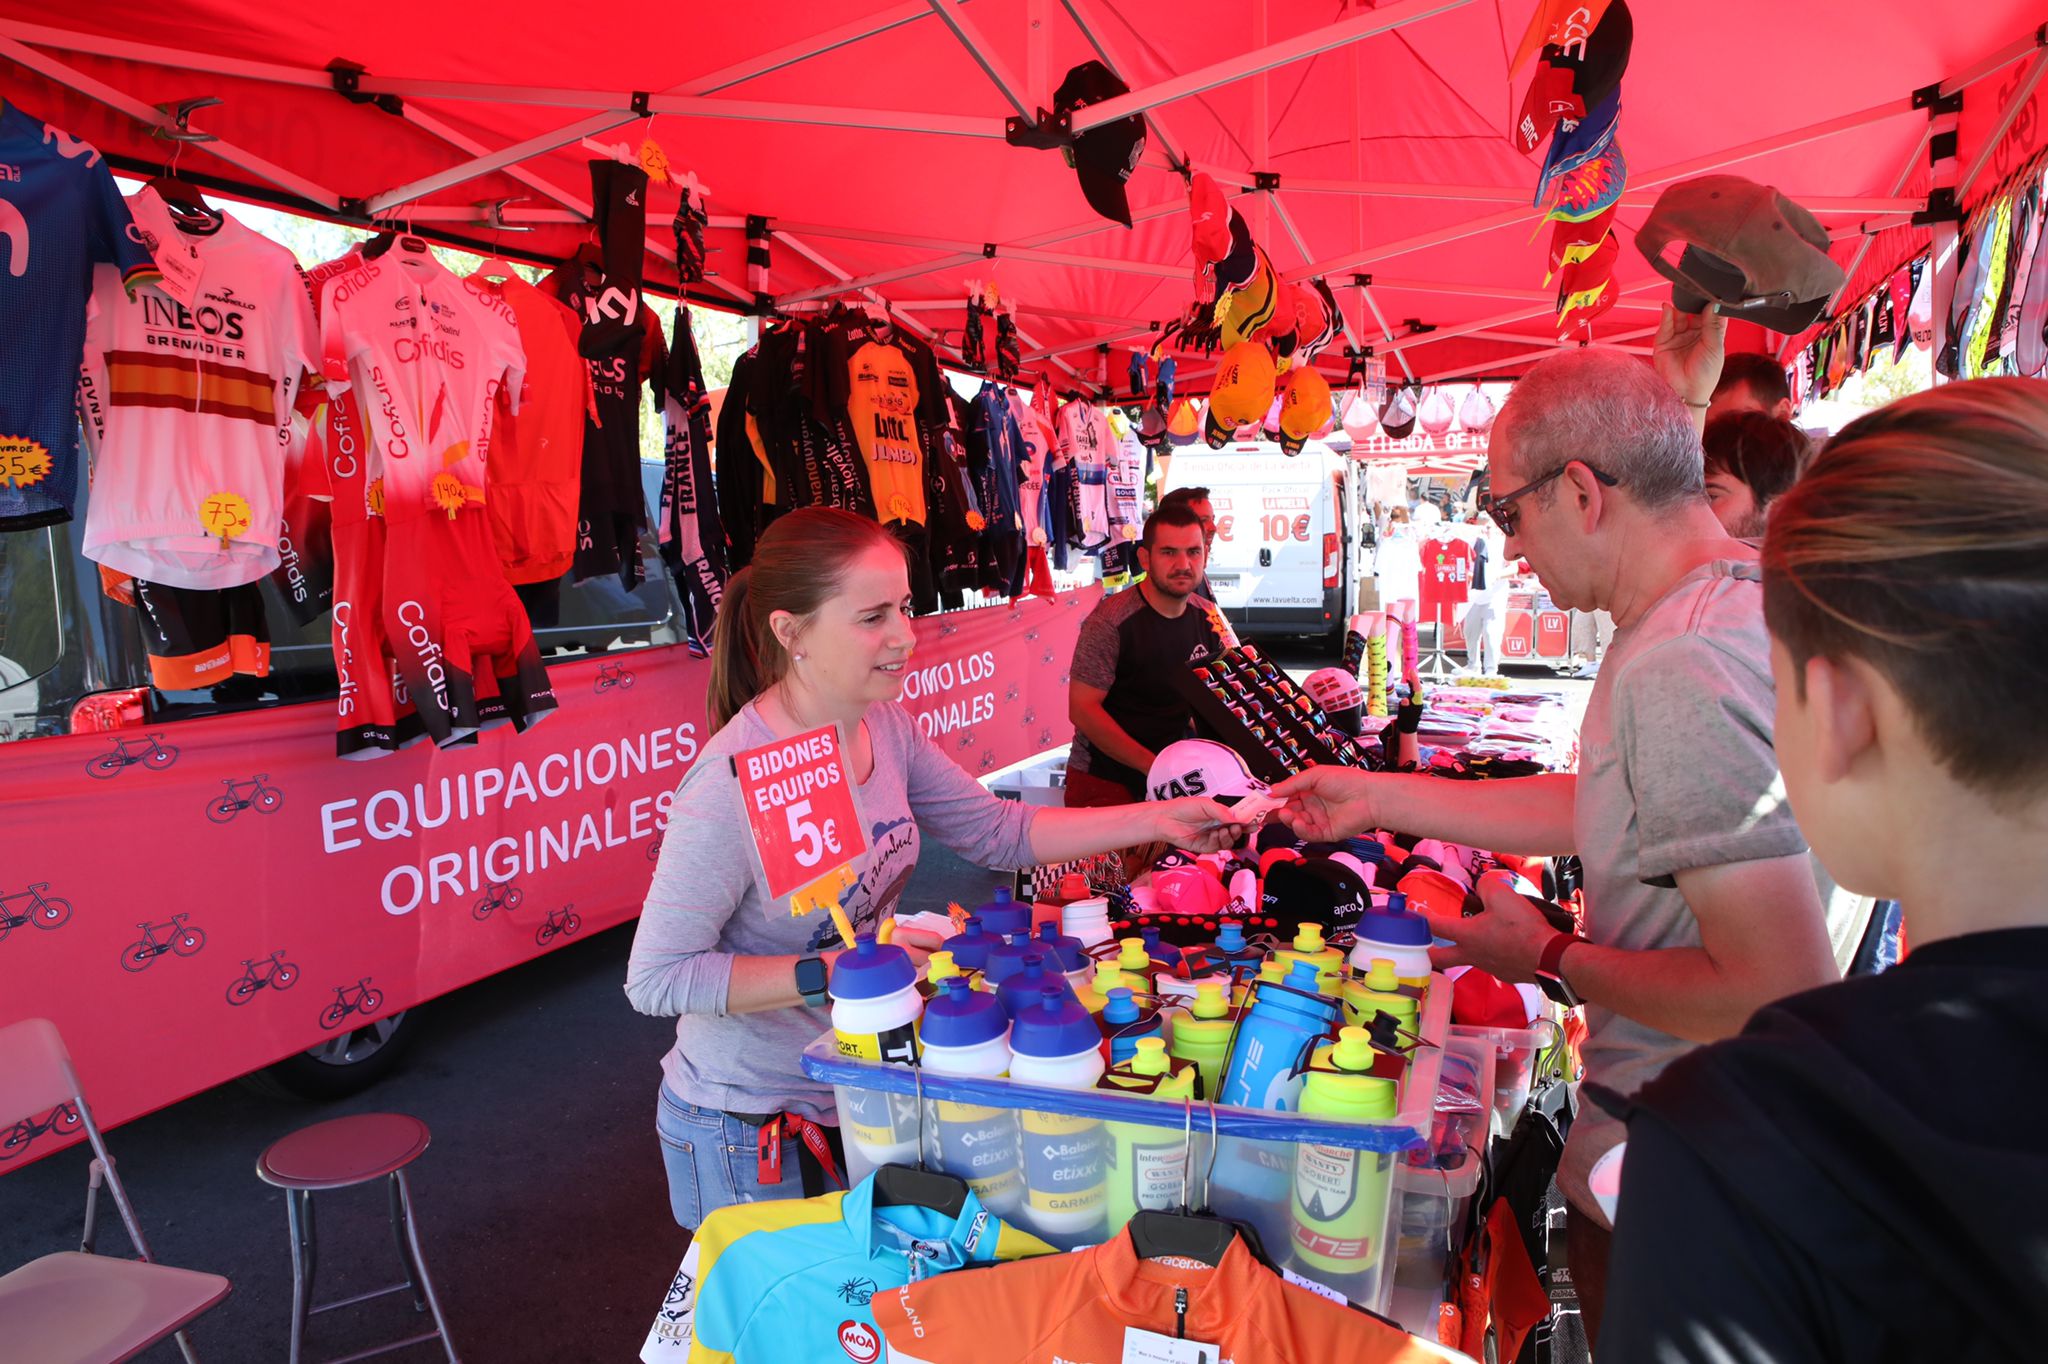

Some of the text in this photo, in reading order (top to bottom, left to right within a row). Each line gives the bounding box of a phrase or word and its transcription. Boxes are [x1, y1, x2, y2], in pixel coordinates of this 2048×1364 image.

[1519, 113, 1539, 150] BMC
[141, 294, 244, 341] INEOS
[204, 292, 256, 311] PINARELLO
[585, 286, 638, 326] KY
[146, 334, 246, 360] GRENADIER
[1366, 432, 1488, 454] TIENDA OFIC
[676, 430, 697, 516] FRANCE
[207, 502, 248, 527] 75€
[1259, 513, 1311, 542] 10€
[1253, 596, 1318, 605] www.lavuelta.com
[1547, 618, 1559, 630] LV
[397, 600, 450, 712] Cofidis
[1510, 638, 1523, 650] LV
[896, 650, 995, 703] OMO LOS
[916, 692, 995, 739] ONALES
[747, 733, 834, 782] BIDONES
[320, 721, 697, 854] EQUIPACIONES
[754, 762, 841, 813] EQUIPOS
[1153, 767, 1207, 801] KAS
[784, 798, 843, 867] 5€
[380, 789, 676, 916] ORIGINALES
[838, 1040, 863, 1055] ORT.
[1233, 1036, 1264, 1107] LITE
[1059, 1139, 1099, 1156] Balois
[1295, 1225, 1362, 1257] LITE
[844, 1331, 875, 1351] MOA
